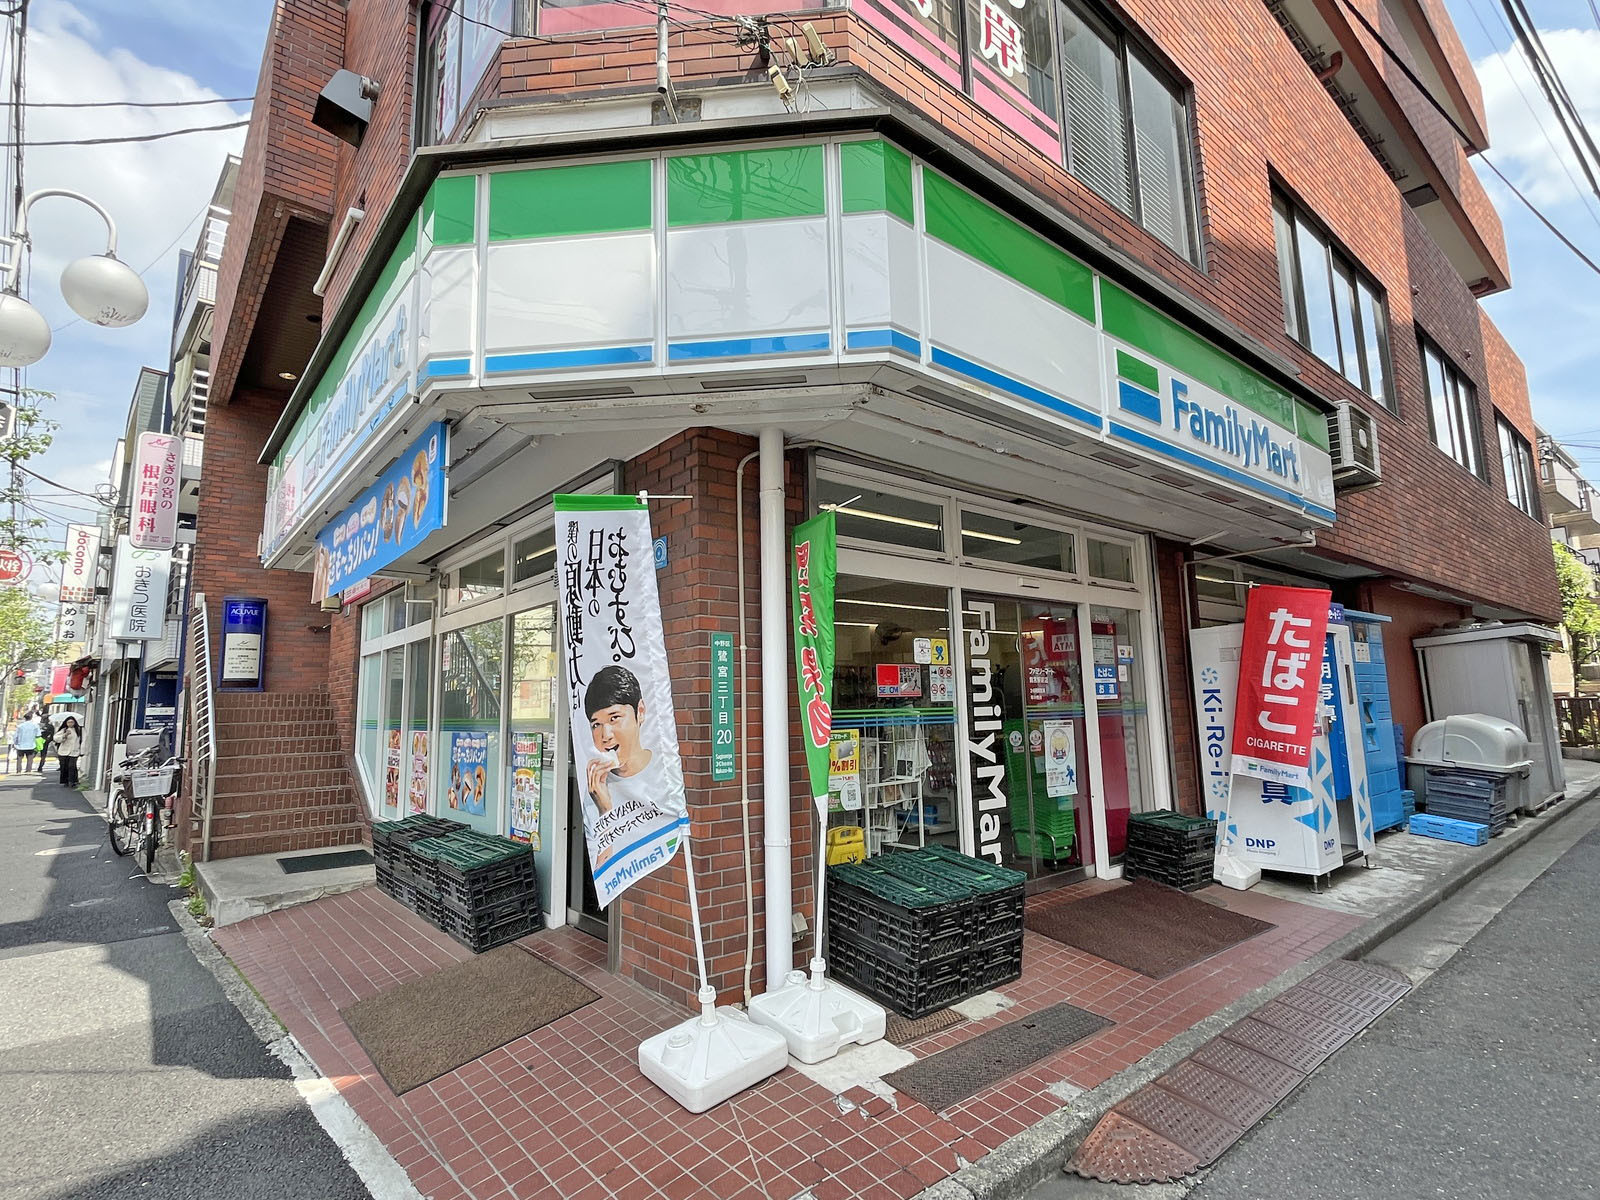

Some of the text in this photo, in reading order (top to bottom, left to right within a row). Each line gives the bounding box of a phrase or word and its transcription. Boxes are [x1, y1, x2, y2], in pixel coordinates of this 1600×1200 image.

[317, 304, 408, 470] FamilyMart
[1170, 376, 1300, 483] FamilyMart
[160, 452, 176, 510] さぎの宮の
[138, 463, 160, 533] 根岸眼科
[73, 530, 90, 576] docomo
[129, 564, 152, 633] おきつ医院
[230, 608, 260, 616] ACUVUE
[1053, 641, 1074, 651] ATM
[1097, 667, 1113, 678] たばこ
[1257, 607, 1312, 735] たばこ
[717, 650, 729, 725] 鷺宮三丁目
[878, 686, 899, 694] SECOM
[716, 729, 732, 745] 20
[1203, 688, 1229, 777] Ki-Re-i
[1246, 736, 1307, 756] CIGARETTE
[829, 759, 857, 773] %割引
[1259, 765, 1299, 780] FamilyMart
[1245, 837, 1276, 849] DNP
[1323, 838, 1335, 851] DNP
